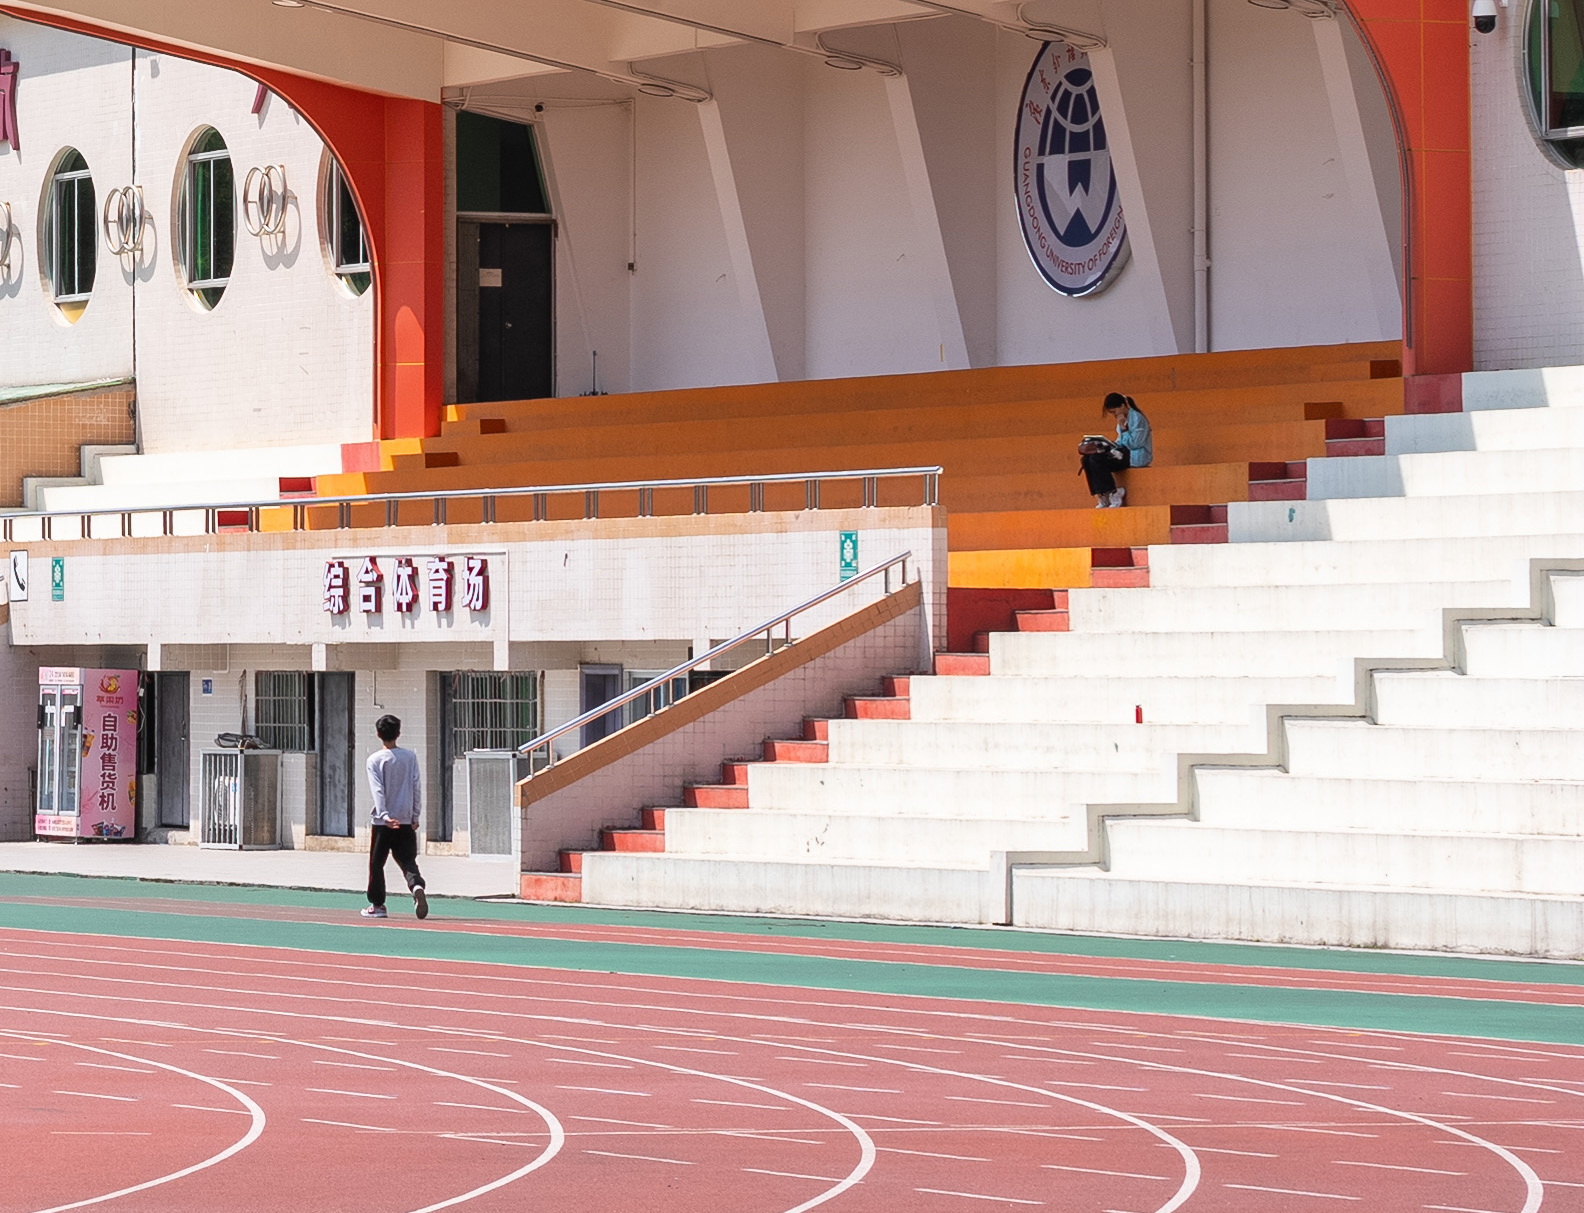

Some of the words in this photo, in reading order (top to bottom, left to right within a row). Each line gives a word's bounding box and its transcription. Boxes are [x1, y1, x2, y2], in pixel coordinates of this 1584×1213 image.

[1022, 146, 1048, 249] GUANGDONG
[1045, 243, 1087, 275] UNIVERSITY
[1087, 254, 1098, 271] OF
[1098, 204, 1124, 262] FOREIGN
[323, 555, 489, 614] 综合体育场
[98, 713, 118, 811] 自助售货机
